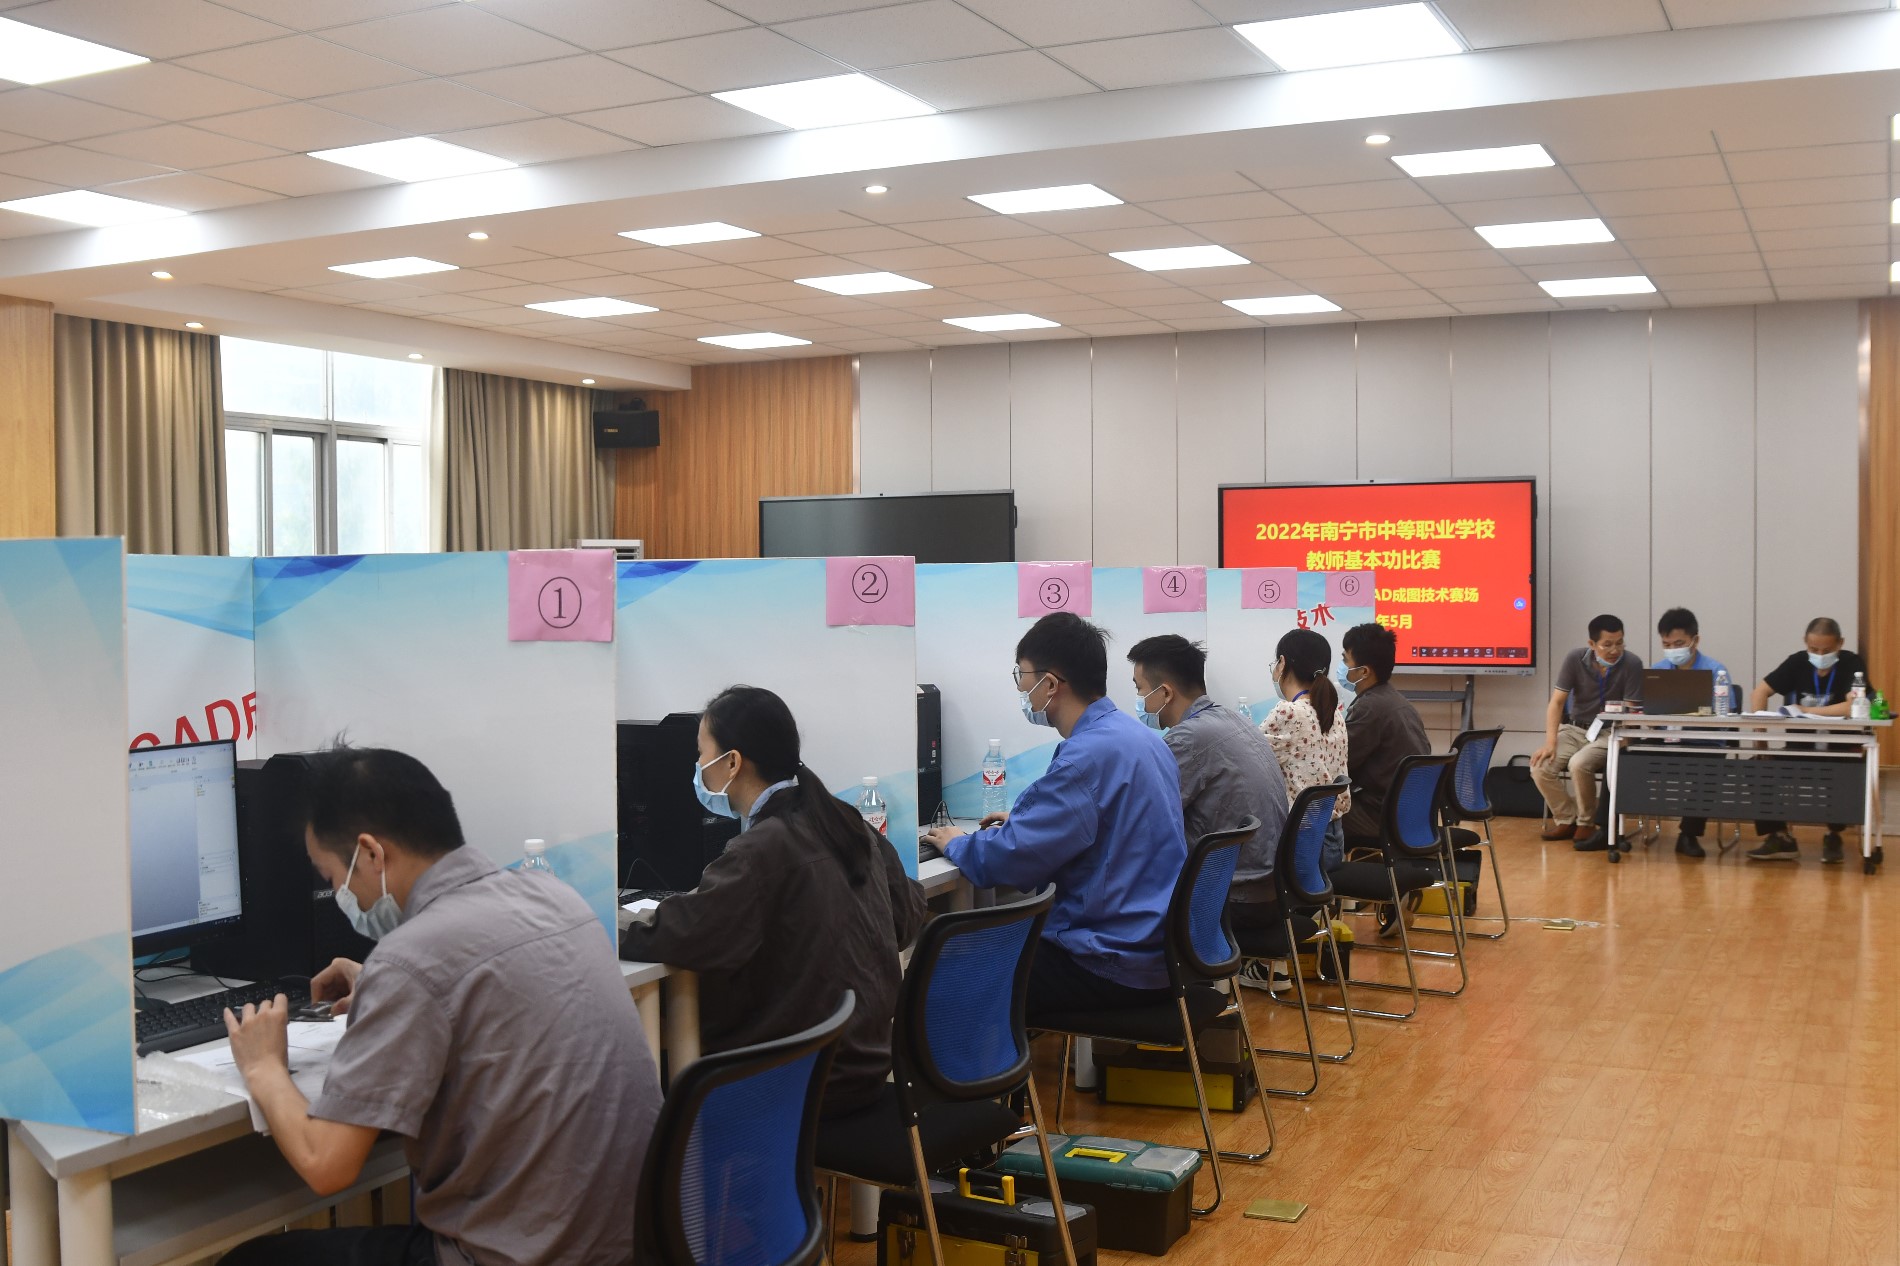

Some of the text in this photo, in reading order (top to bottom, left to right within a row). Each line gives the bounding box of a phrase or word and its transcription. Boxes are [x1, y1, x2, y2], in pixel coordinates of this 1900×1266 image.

[1255, 518, 1496, 543] 2022年南宁市中等职业学校
[1306, 549, 1441, 571] 教师基本功比赛
[317, 889, 334, 898] acer
